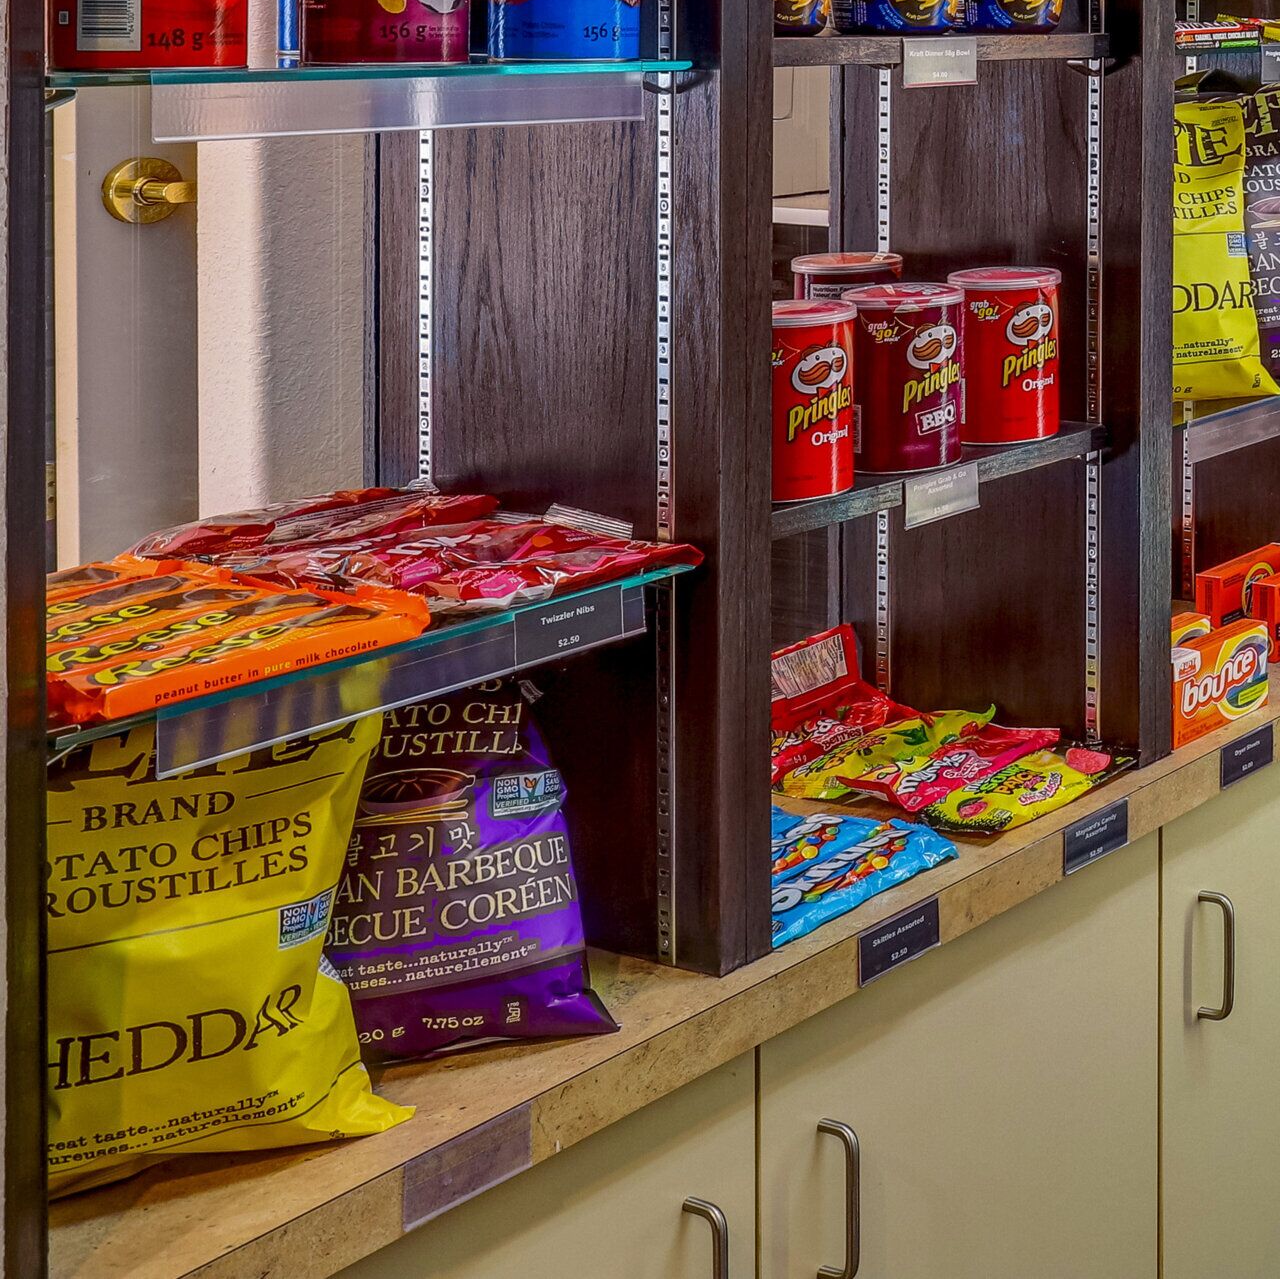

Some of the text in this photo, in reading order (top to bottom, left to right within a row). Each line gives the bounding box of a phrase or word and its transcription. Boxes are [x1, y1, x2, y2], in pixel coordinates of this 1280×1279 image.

[380, 24, 411, 41] 156
[909, 49, 922, 58] Kraft
[955, 49, 970, 57] Bowl
[1178, 184, 1236, 205] CHIPS
[1003, 338, 1057, 387] Pringles
[902, 361, 960, 413] Pringles
[1022, 374, 1054, 391] Original
[788, 383, 851, 441] Pringles
[920, 407, 956, 431] BBQ
[811, 425, 848, 446] Original
[540, 604, 595, 626] Twizzler Nibs
[557, 633, 580, 648] $2.50
[154, 637, 379, 704] peanut butter in pure milk chocolate
[1182, 647, 1257, 713] bounce
[81, 790, 236, 833] BRAND
[1101, 813, 1117, 826] Candy
[190, 811, 313, 859] CHIPS
[1085, 824, 1108, 840] Assorted
[396, 836, 568, 899] BARBEQUE
[440, 872, 573, 932] CORÉEN
[872, 915, 924, 947] Skittles Assorted
[891, 947, 908, 961] $2.50
[422, 1015, 458, 1032] 7.75
